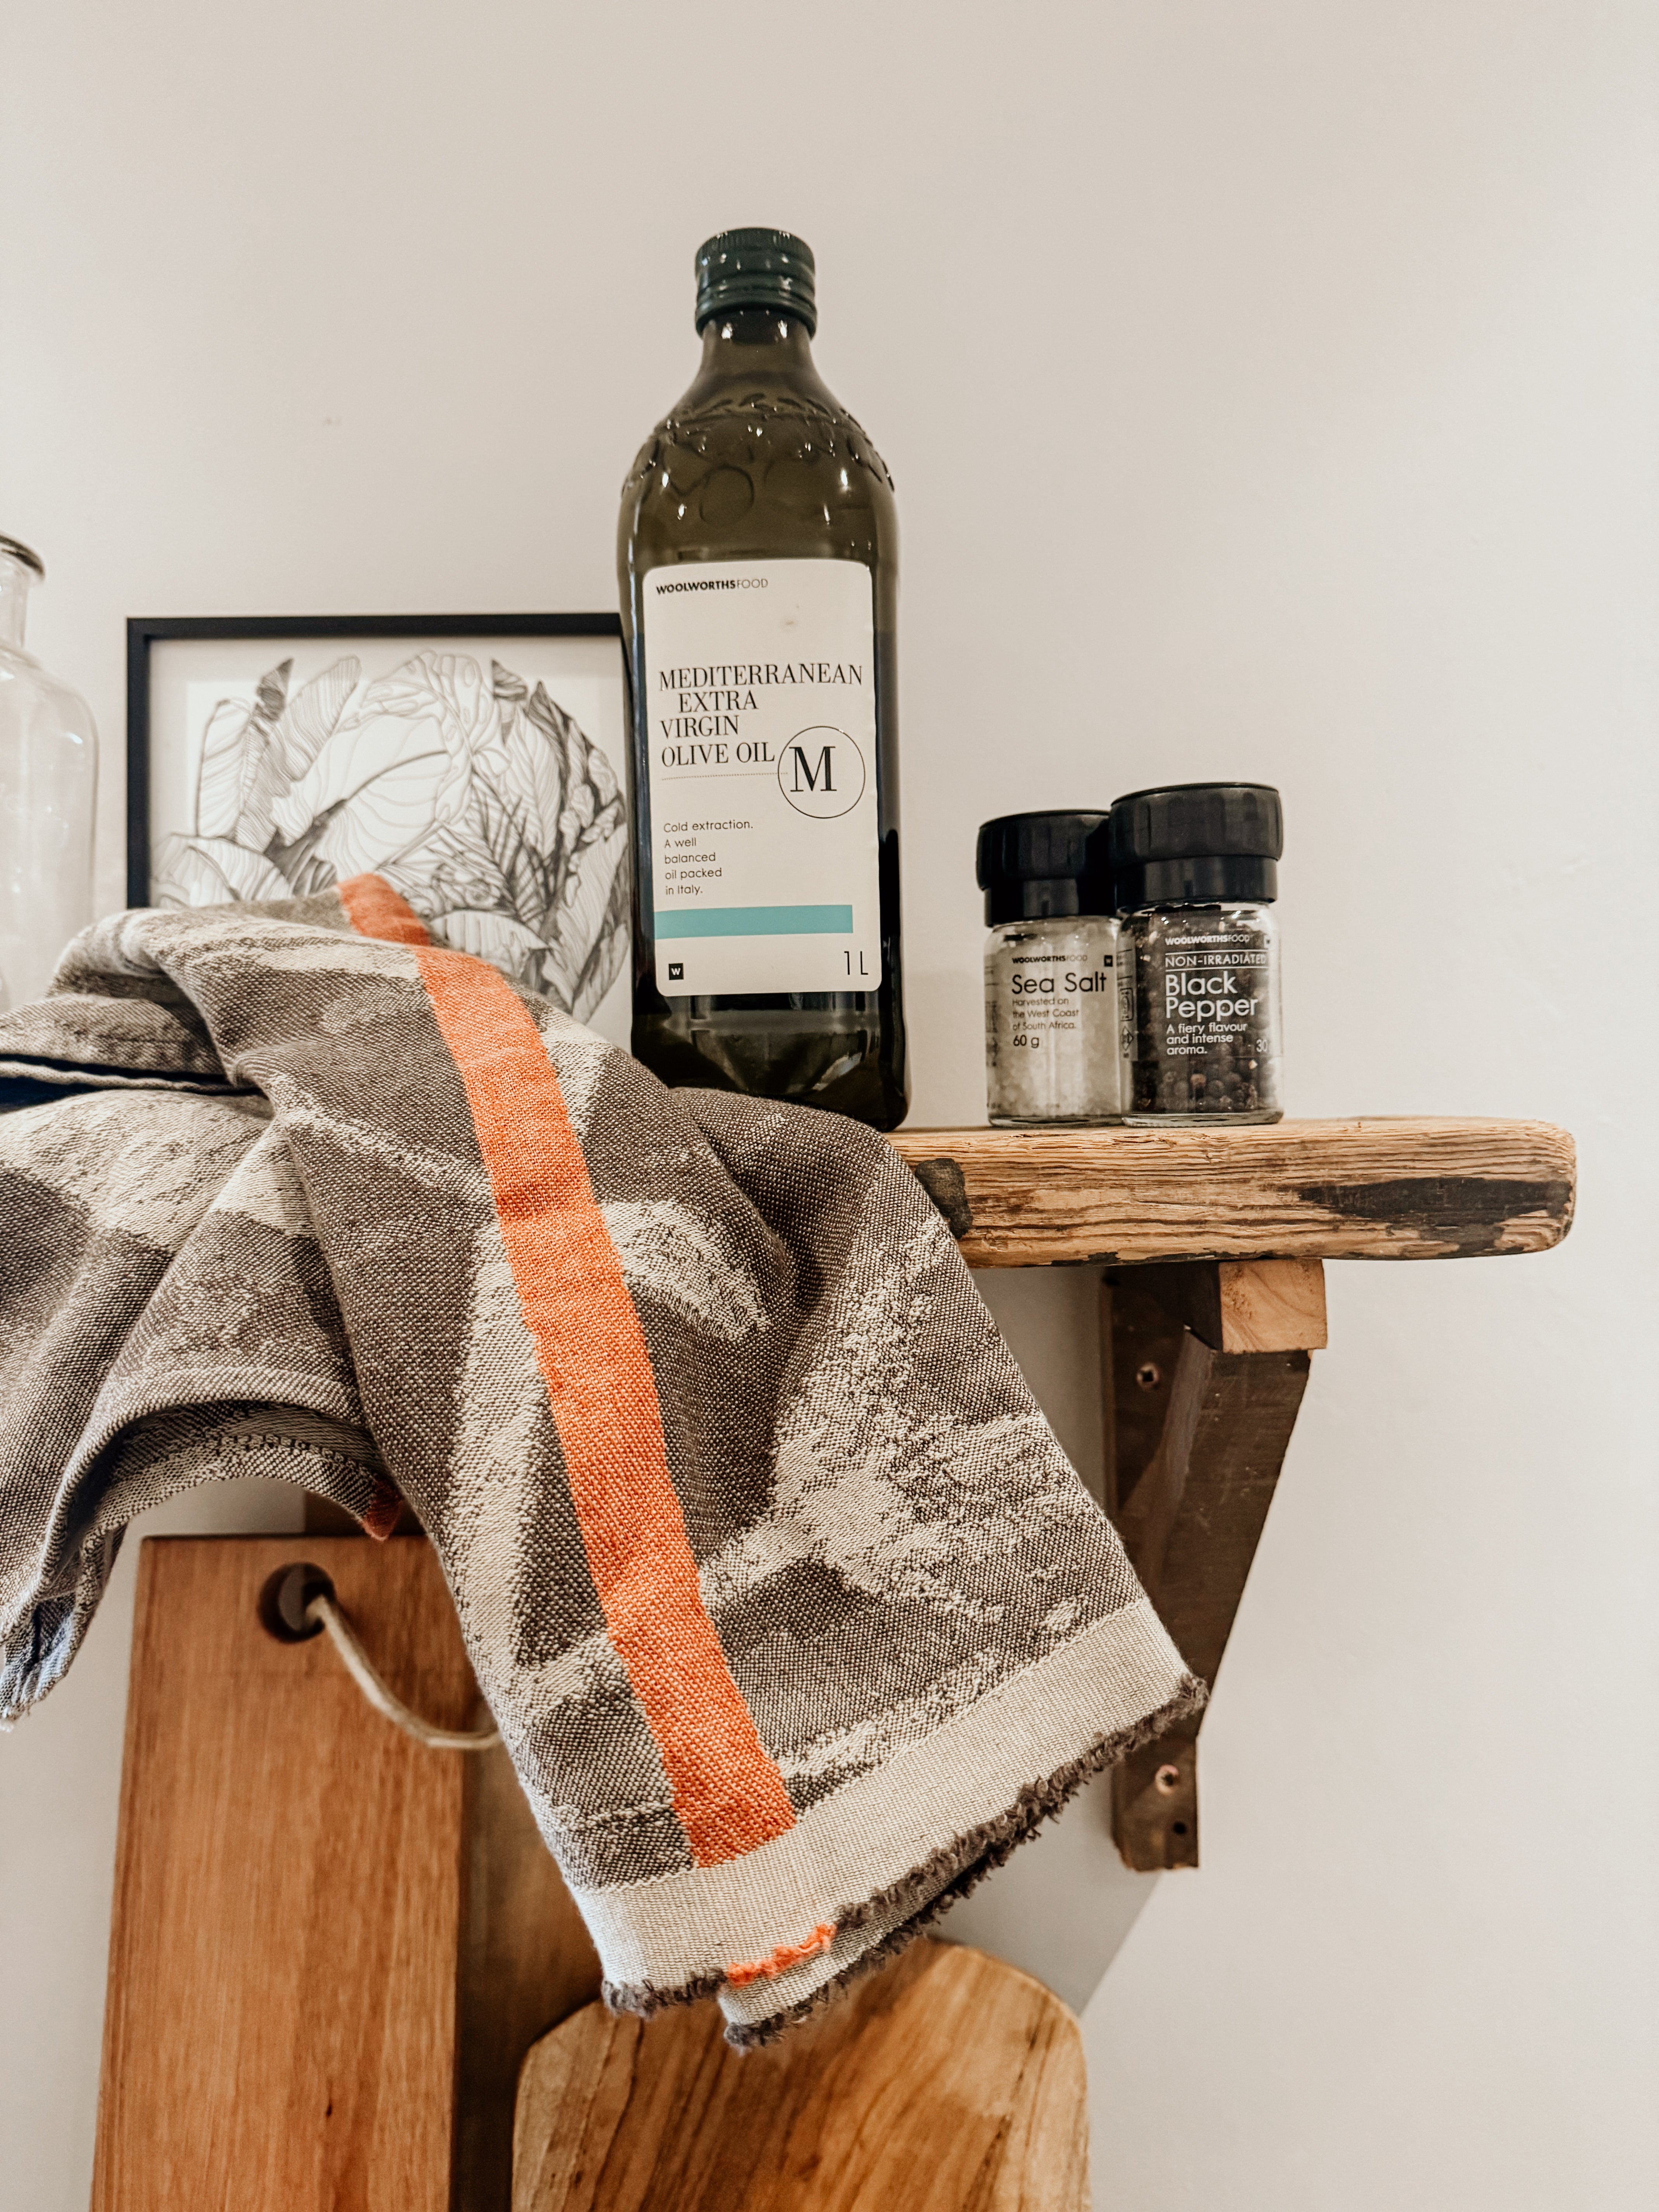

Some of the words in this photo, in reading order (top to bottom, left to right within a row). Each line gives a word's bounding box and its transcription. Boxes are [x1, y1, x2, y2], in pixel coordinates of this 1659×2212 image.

[656, 579, 768, 594] WOOLWORTHSFOOD
[659, 663, 863, 692] MEDITERRANEAN
[678, 690, 758, 713] EXTRA
[660, 715, 739, 739] VIRGIN
[662, 743, 729, 767] OLIVE
[736, 742, 775, 763] OIL
[789, 746, 837, 792] M
[664, 822, 687, 833] Cold
[692, 819, 753, 830] extraction.
[665, 839, 671, 848] A
[675, 837, 696, 847] well
[665, 852, 716, 864] balanced
[665, 870, 677, 879] oil
[680, 867, 722, 880] packed
[666, 886, 674, 895] in
[678, 884, 703, 895] Italy.
[1165, 954, 1266, 967] NON-IRRADIATED
[1012, 974, 1054, 994] Sea
[1065, 971, 1107, 992] Salt
[1166, 971, 1238, 996] Black
[1012, 996, 1055, 1006] Harvested
[1013, 1010, 1025, 1018] the
[1053, 1008, 1079, 1017] Coast
[1166, 997, 1258, 1022] Pepper
[1013, 1022, 1020, 1030] of
[1023, 1022, 1046, 1030] South
[1049, 1020, 1076, 1029] Africa.
[1166, 1024, 1175, 1034] A
[1178, 1024, 1205, 1034] fiery
[1209, 1022, 1248, 1032] flavour
[1013, 1034, 1027, 1046] 60
[1031, 1037, 1039, 1048] g
[1167, 1034, 1189, 1045] and
[1192, 1033, 1233, 1043] intense
[1256, 1039, 1267, 1053] 30
[1167, 1046, 1208, 1056] aroma.
